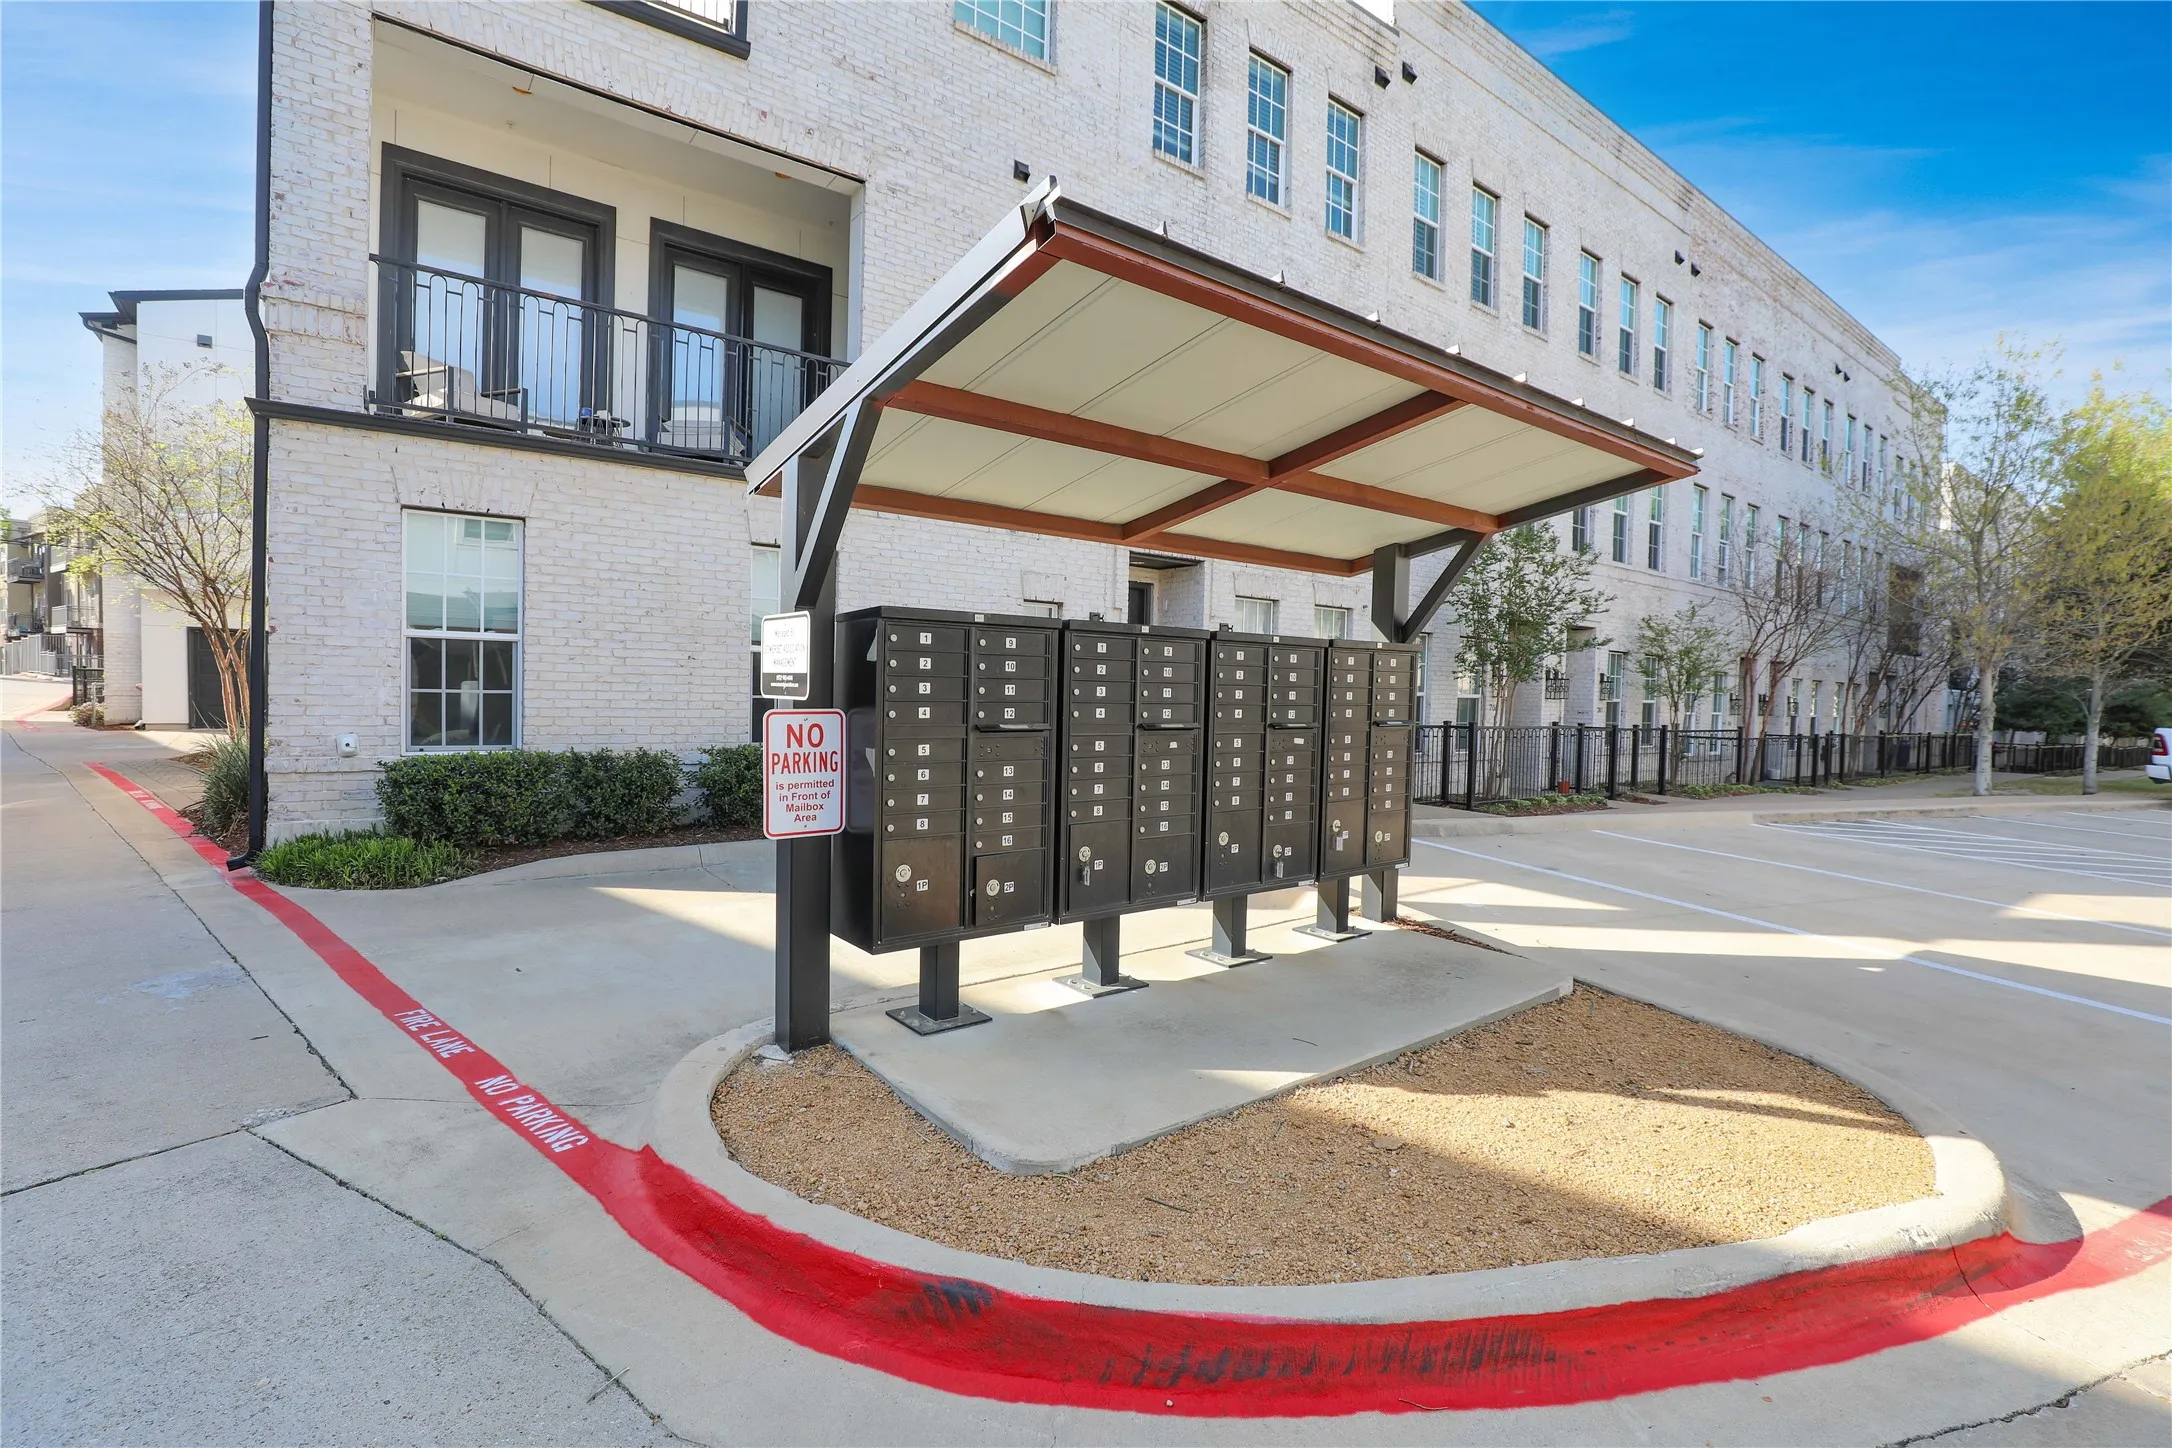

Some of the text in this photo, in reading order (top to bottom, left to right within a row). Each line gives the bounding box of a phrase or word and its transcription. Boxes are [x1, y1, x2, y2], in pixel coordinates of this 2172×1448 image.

[923, 659, 928, 667] 2
[922, 684, 928, 692] 3
[786, 723, 824, 748] NO
[921, 746, 927, 754] 5
[771, 751, 838, 775] PARKING
[920, 770, 926, 779] 6
[775, 779, 834, 792] is permitted
[792, 791, 818, 801] Front
[821, 791, 831, 799] of
[786, 803, 824, 812] Mailbox
[794, 814, 817, 822] Area
[919, 820, 925, 828] 8
[918, 881, 927, 890] 1P
[1004, 883, 1014, 891] 2P
[394, 1008, 589, 1153] FIRE LANE NO PARKING
